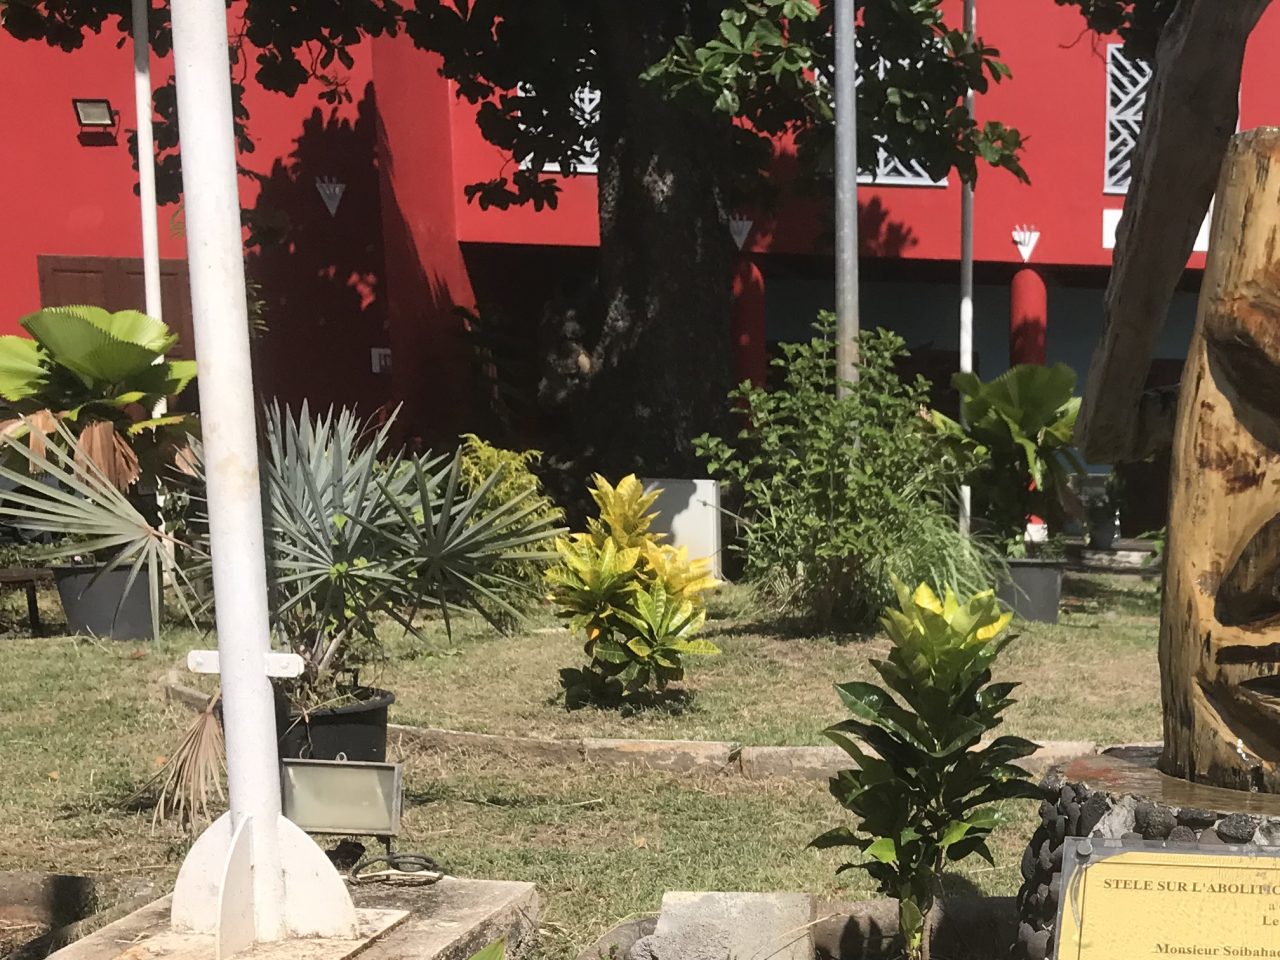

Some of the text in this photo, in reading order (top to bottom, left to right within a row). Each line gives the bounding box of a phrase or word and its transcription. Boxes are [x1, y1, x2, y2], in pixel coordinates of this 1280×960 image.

[1104, 879, 1153, 891] STELE
[1157, 881, 1188, 892] SUR
[1269, 903, 1275, 911] a
[1262, 916, 1279, 926] Le
[1156, 943, 1219, 956] Monsieur
